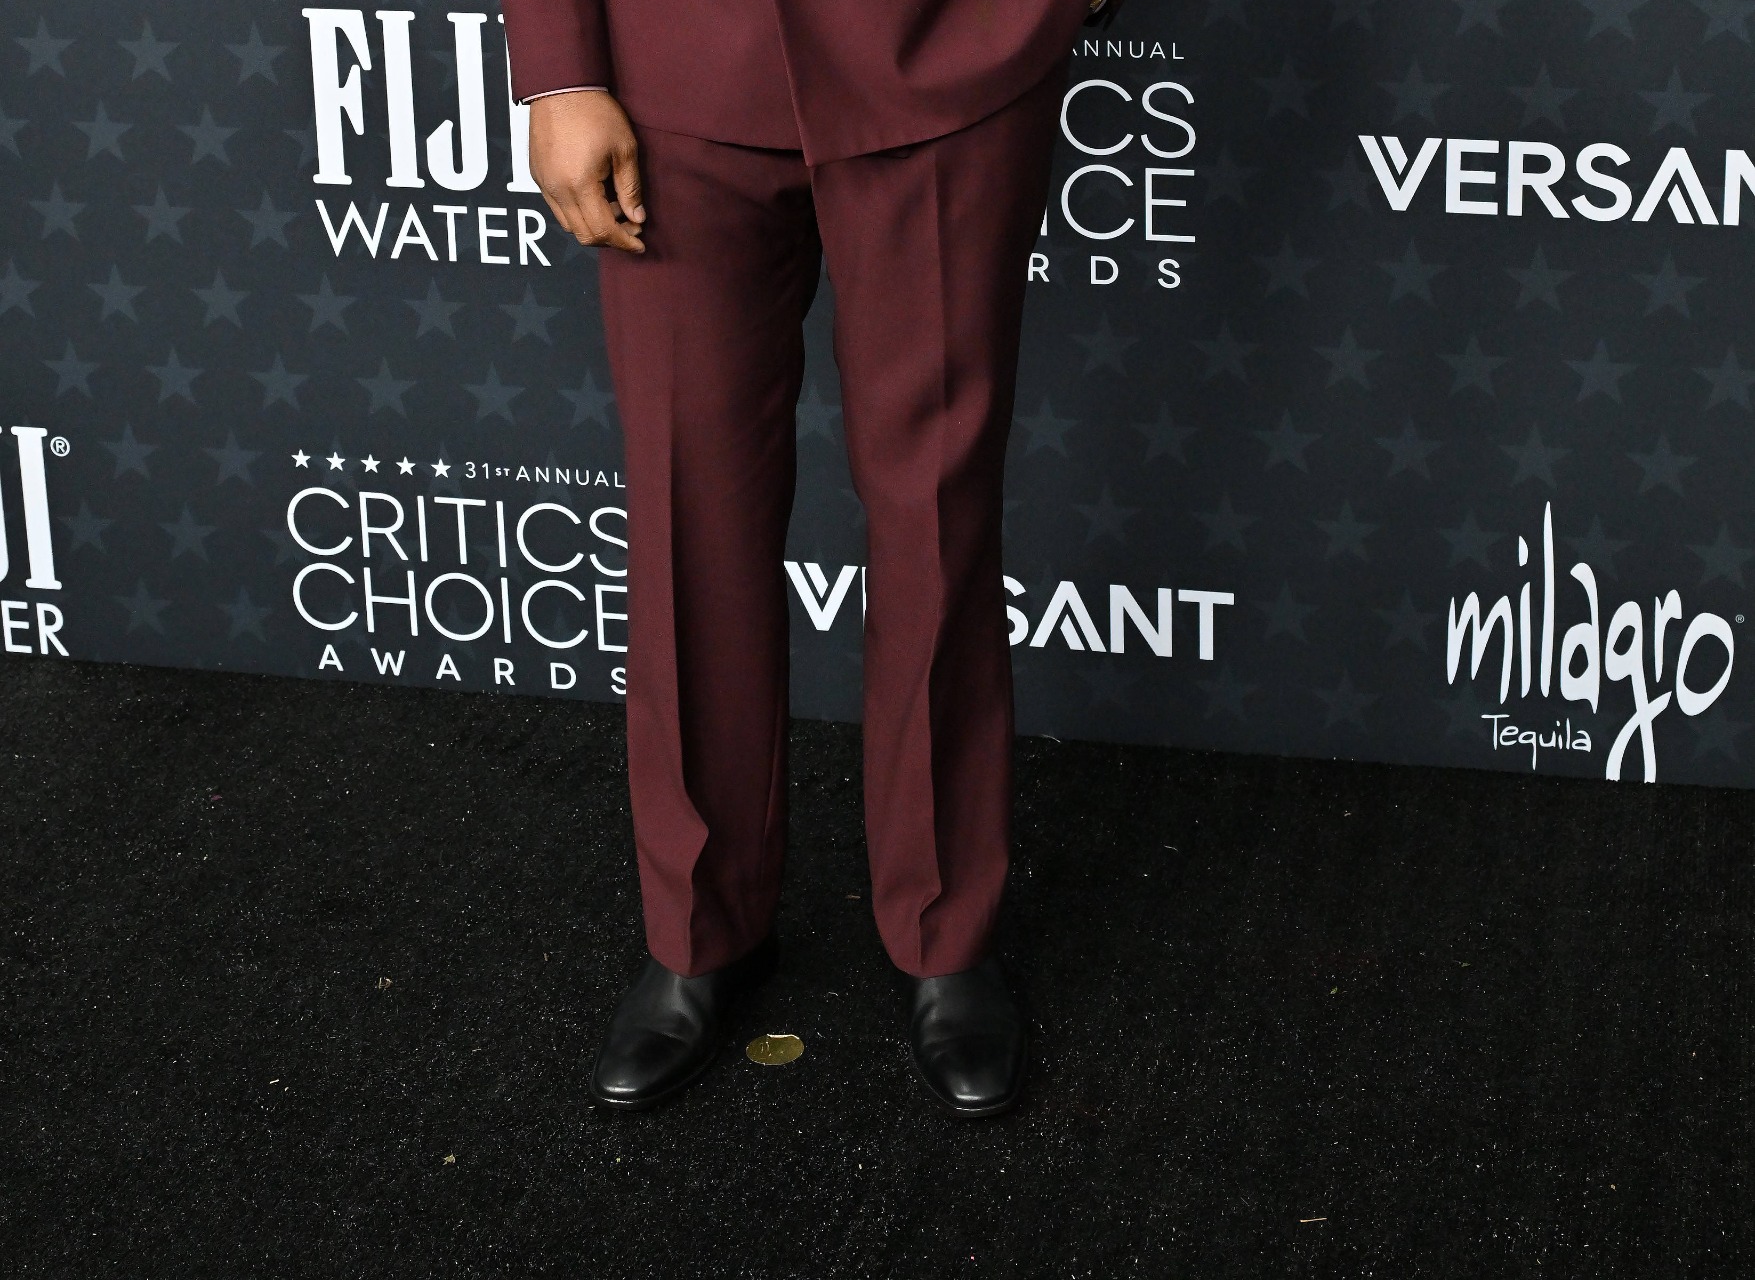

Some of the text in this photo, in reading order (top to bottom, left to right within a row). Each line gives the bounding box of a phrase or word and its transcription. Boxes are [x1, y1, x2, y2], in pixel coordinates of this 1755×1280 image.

[1072, 40, 1185, 60] NNUAL
[315, 200, 551, 267] WATER
[515, 465, 627, 489] ANNUAL
[286, 486, 628, 578] CRITICS
[292, 562, 628, 653] CHOICE
[318, 643, 627, 696] AWARDS
[1446, 501, 1735, 784] milagro
[1481, 714, 1592, 771] Tequila
